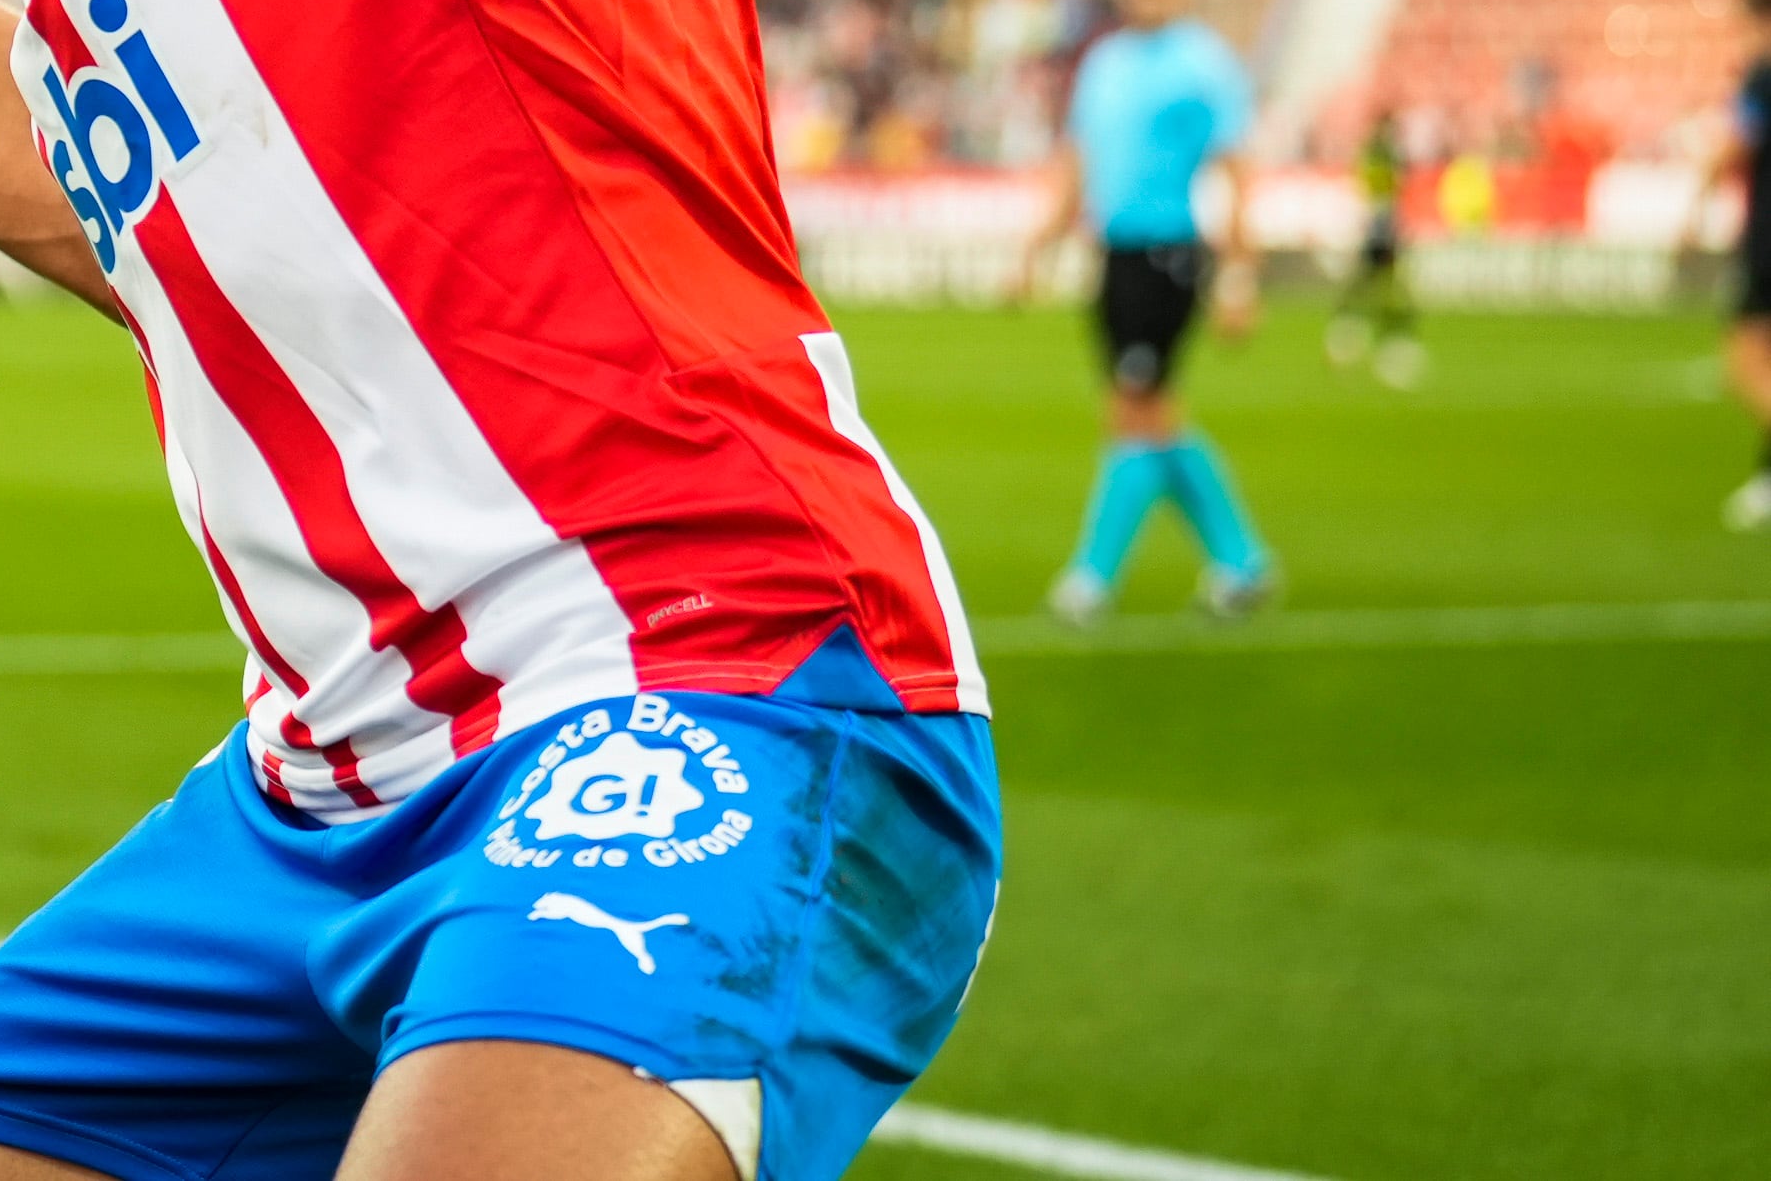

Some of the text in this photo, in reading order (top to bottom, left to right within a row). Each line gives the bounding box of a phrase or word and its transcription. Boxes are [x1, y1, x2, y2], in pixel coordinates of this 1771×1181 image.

[498, 694, 750, 820] Costa Brava
[572, 845, 629, 868] de
[642, 808, 753, 868] Girona
